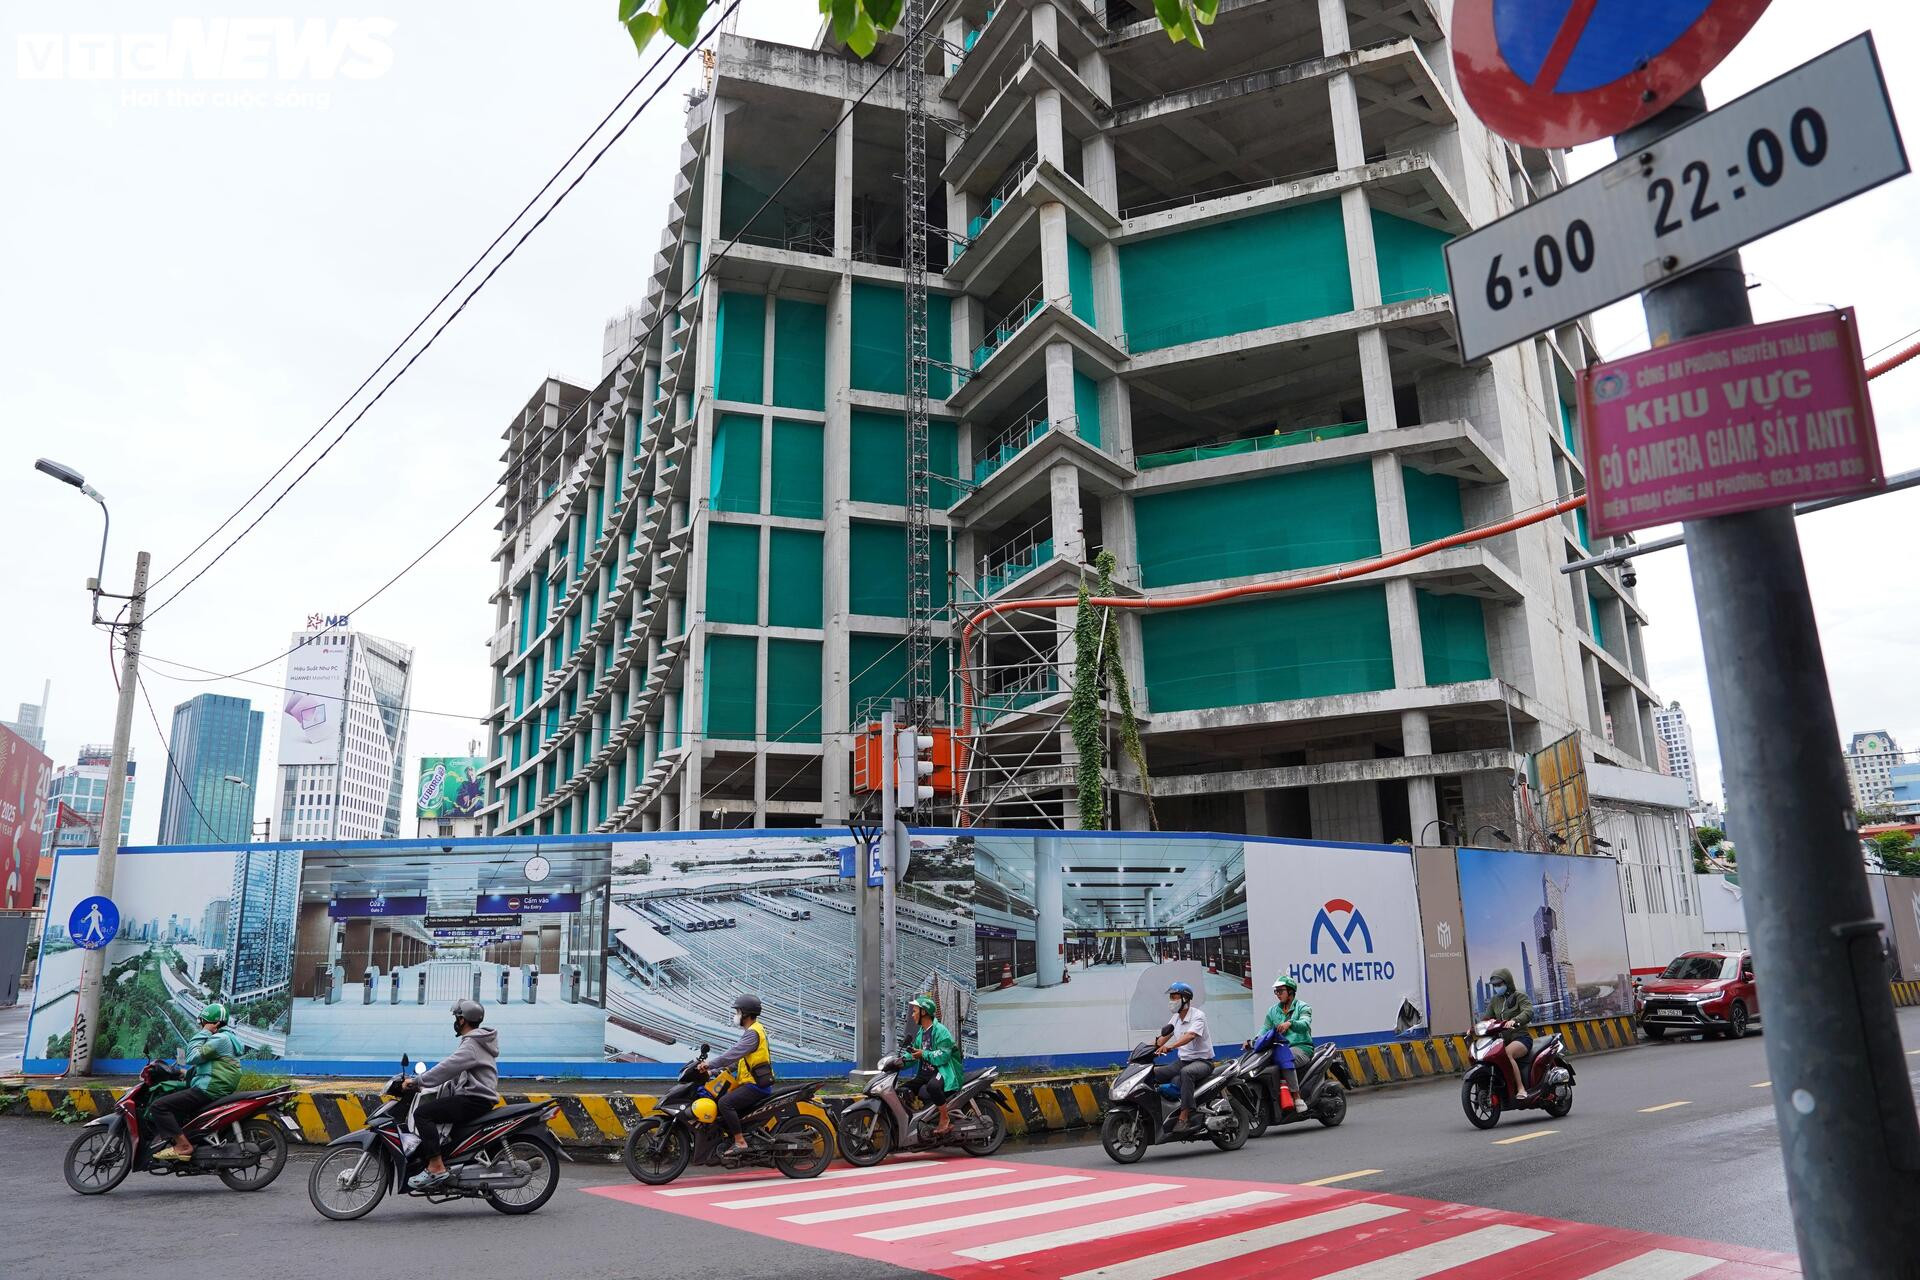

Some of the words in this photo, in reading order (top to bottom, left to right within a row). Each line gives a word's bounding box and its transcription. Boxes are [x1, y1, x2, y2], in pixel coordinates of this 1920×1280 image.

[1646, 106, 1829, 239] 22:00
[1485, 218, 1595, 312] 6:00
[1668, 363, 1684, 381] AN
[1626, 387, 1709, 433] KHU
[1722, 368, 1812, 410] VỰC
[1601, 443, 1624, 491] CÓ
[1627, 437, 1704, 485] CAMERA
[1706, 418, 1758, 467] GIÁM
[1761, 408, 1800, 457] SÁT
[1806, 406, 1857, 449] ANTT
[1698, 481, 1714, 498] AN
[325, 615, 349, 628] MB
[30, 797, 47, 834] 25
[1289, 962, 1338, 984] HCMC
[1342, 960, 1395, 982] METRO
